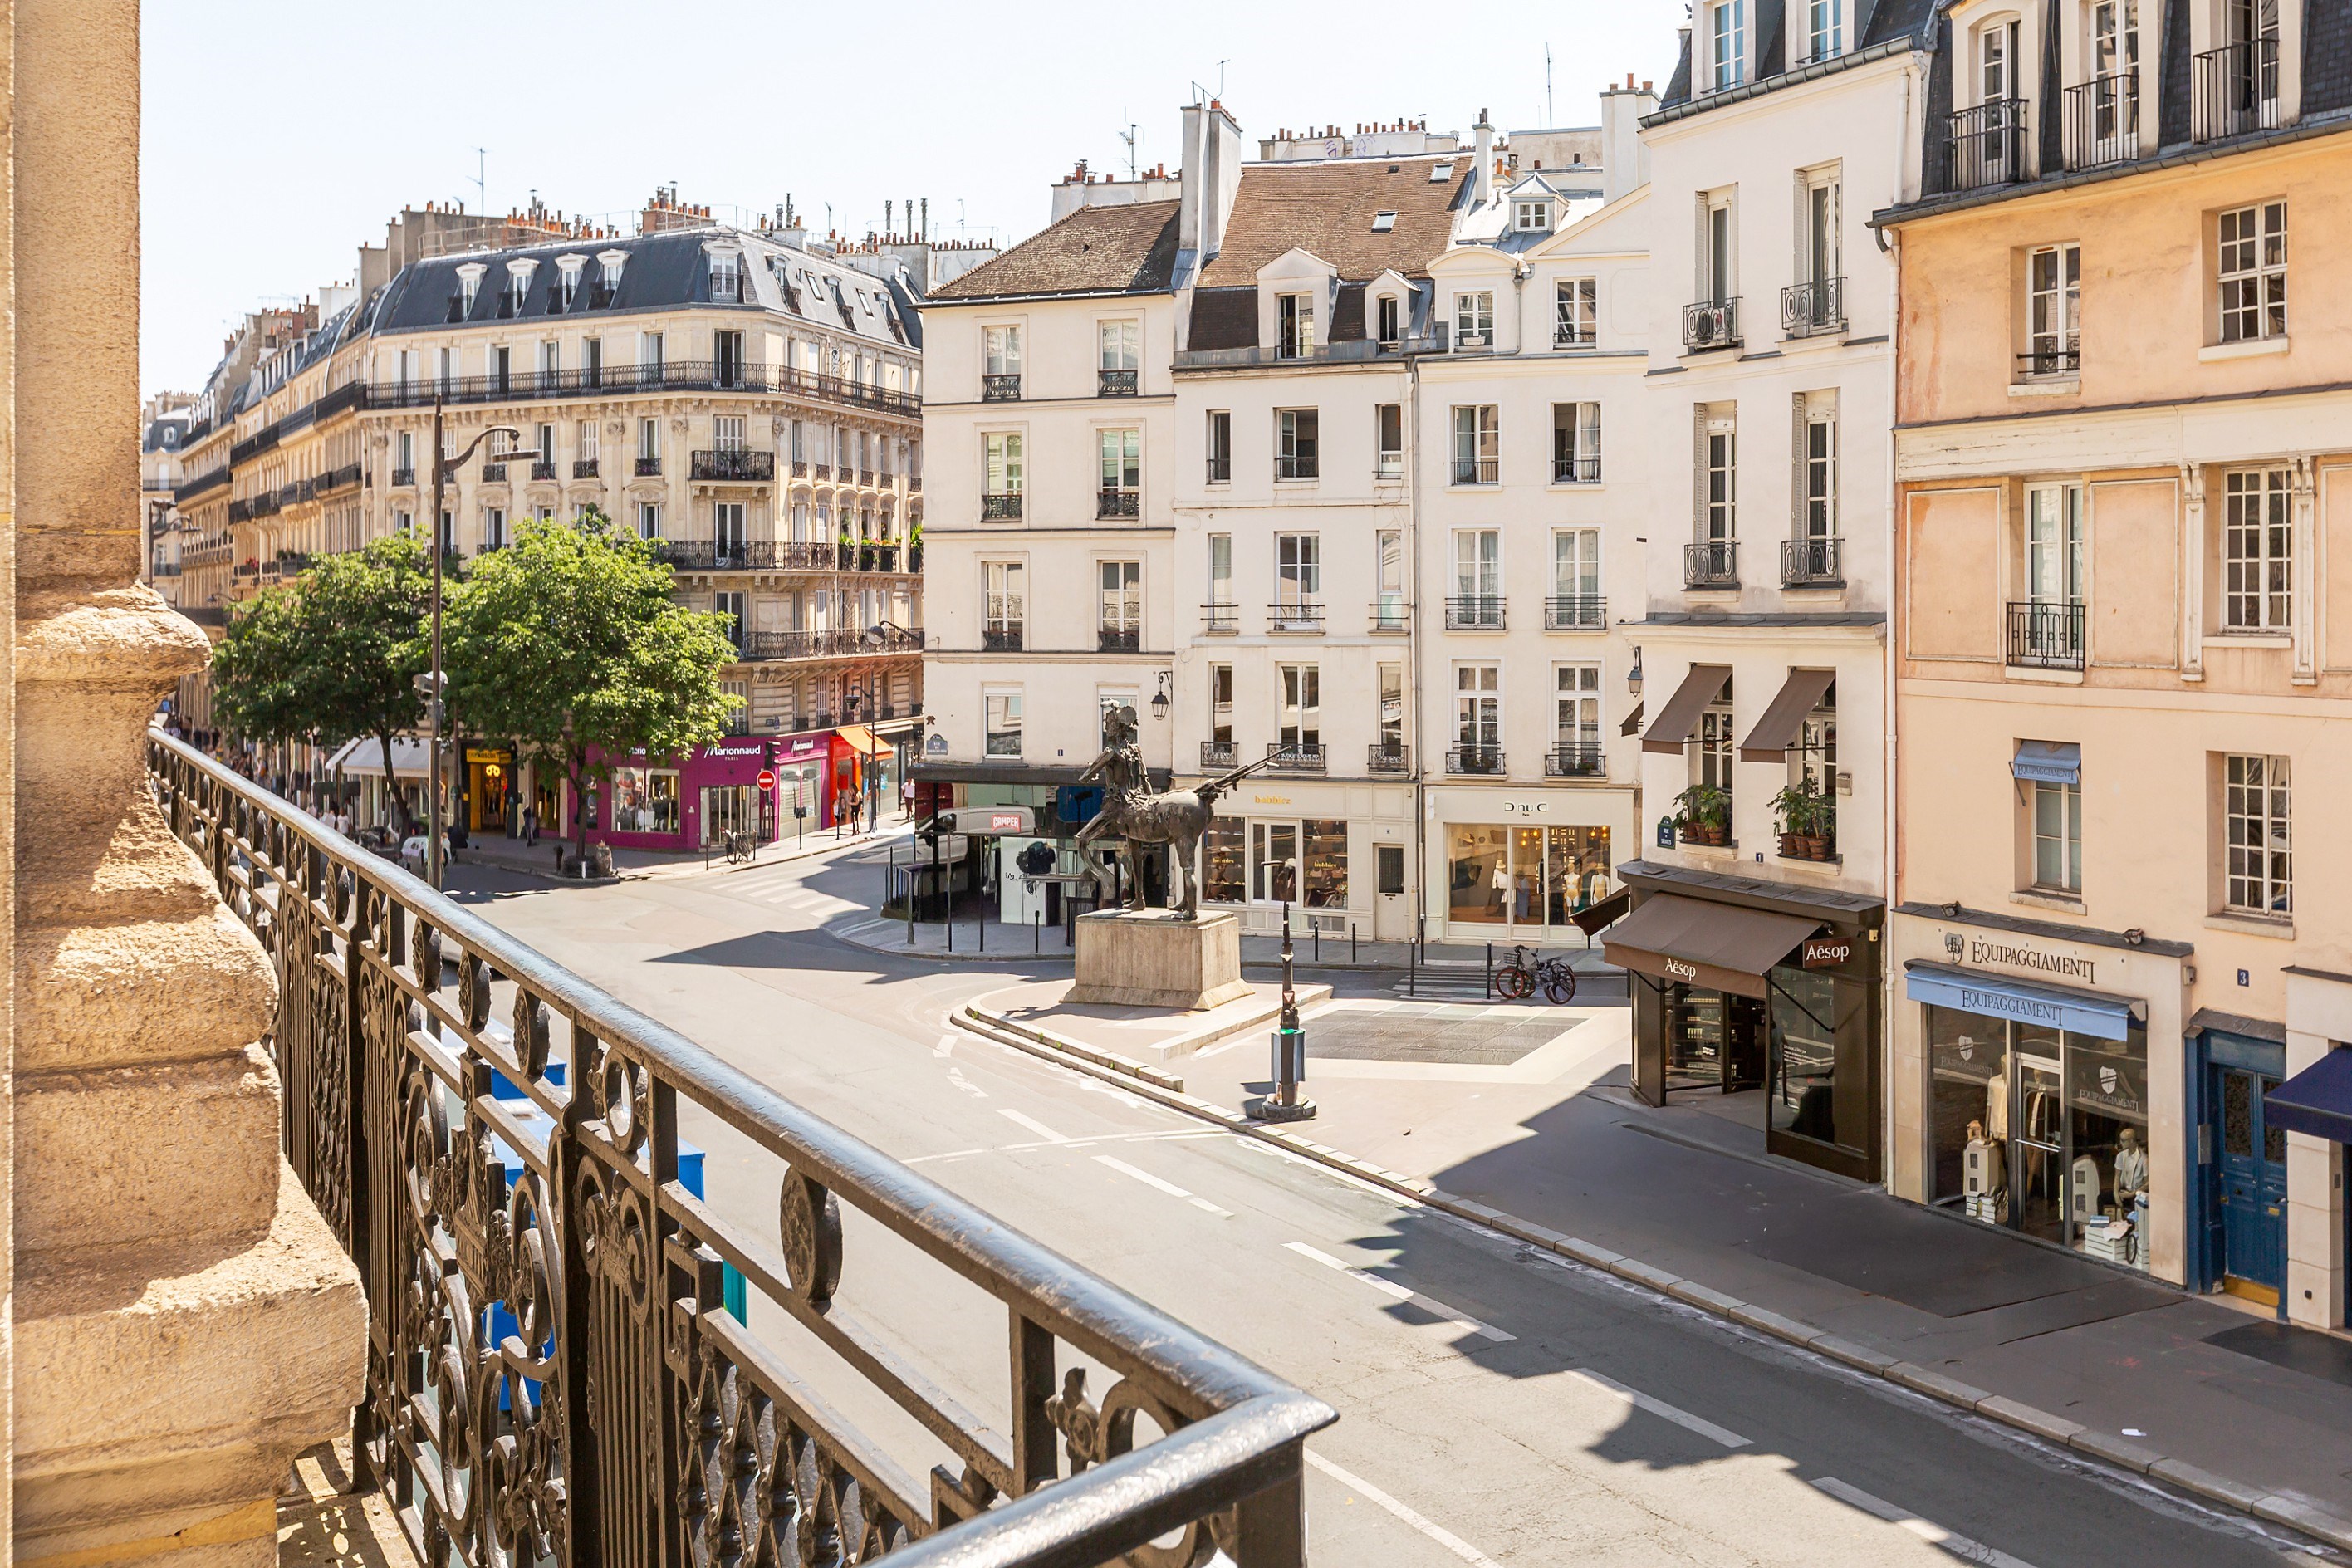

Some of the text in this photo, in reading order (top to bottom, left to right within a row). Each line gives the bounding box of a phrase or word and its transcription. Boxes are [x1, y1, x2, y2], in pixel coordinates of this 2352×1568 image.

[704, 745, 761, 758] Marionnaud
[992, 816, 1019, 828] CAMPER
[1806, 944, 1850, 963] Aēsop
[1972, 941, 2096, 985] EQUIPAGGIAMENTI
[1664, 958, 1696, 982] Aēsop
[1962, 990, 2063, 1027] EQUIPAGGIAMENTI
